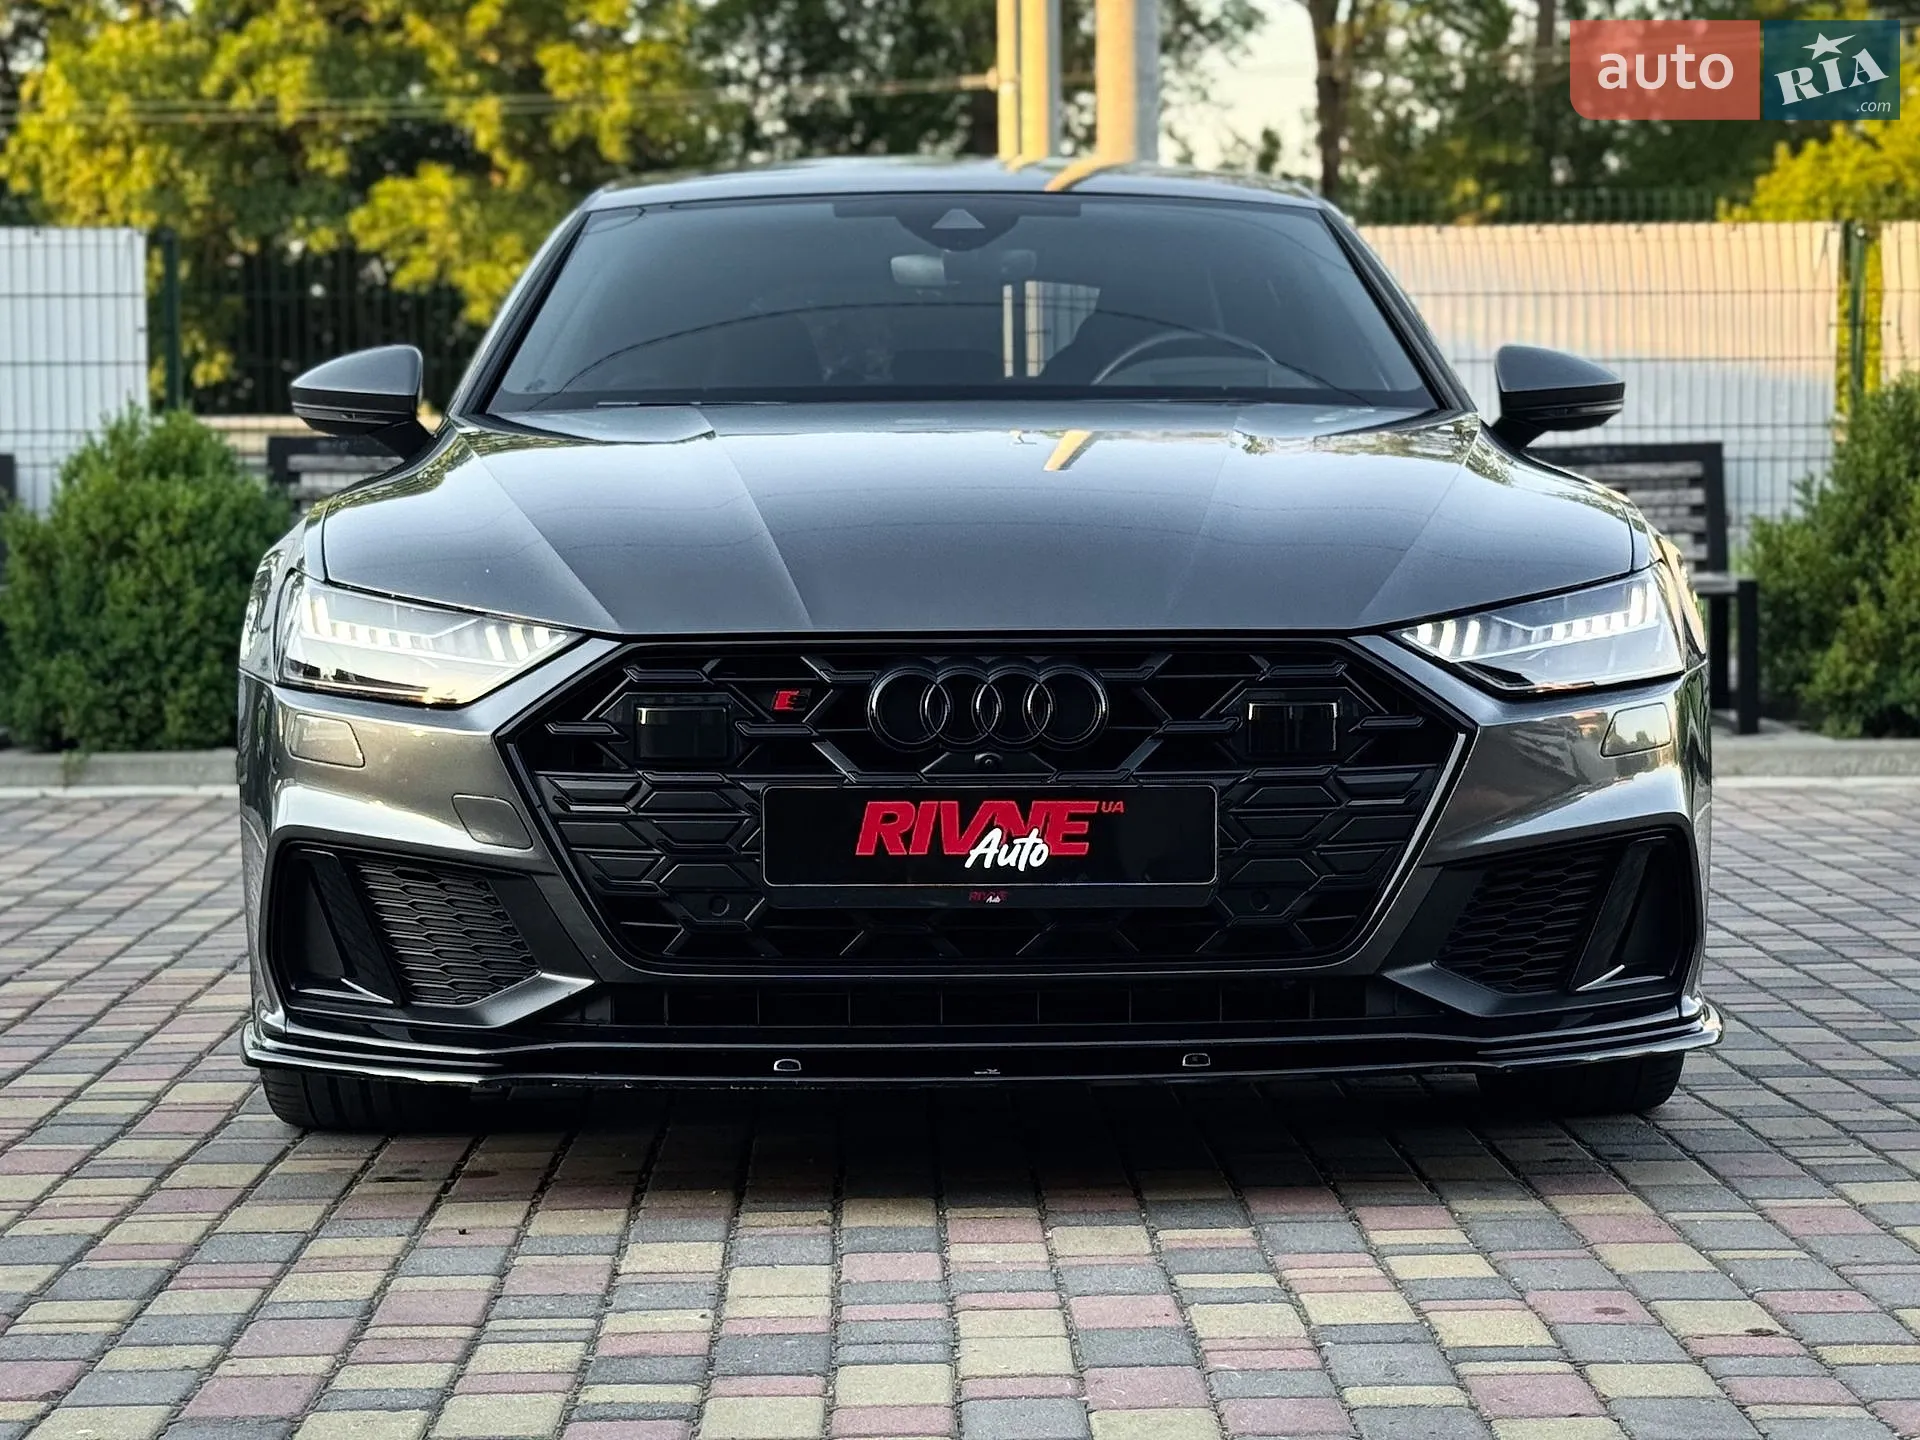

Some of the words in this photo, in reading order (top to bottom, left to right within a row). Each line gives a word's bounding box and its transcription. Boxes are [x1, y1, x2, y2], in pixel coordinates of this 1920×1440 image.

[855, 801, 1099, 855] RIVNE
[1100, 801, 1125, 813] UA
[964, 828, 1049, 871] Auto
